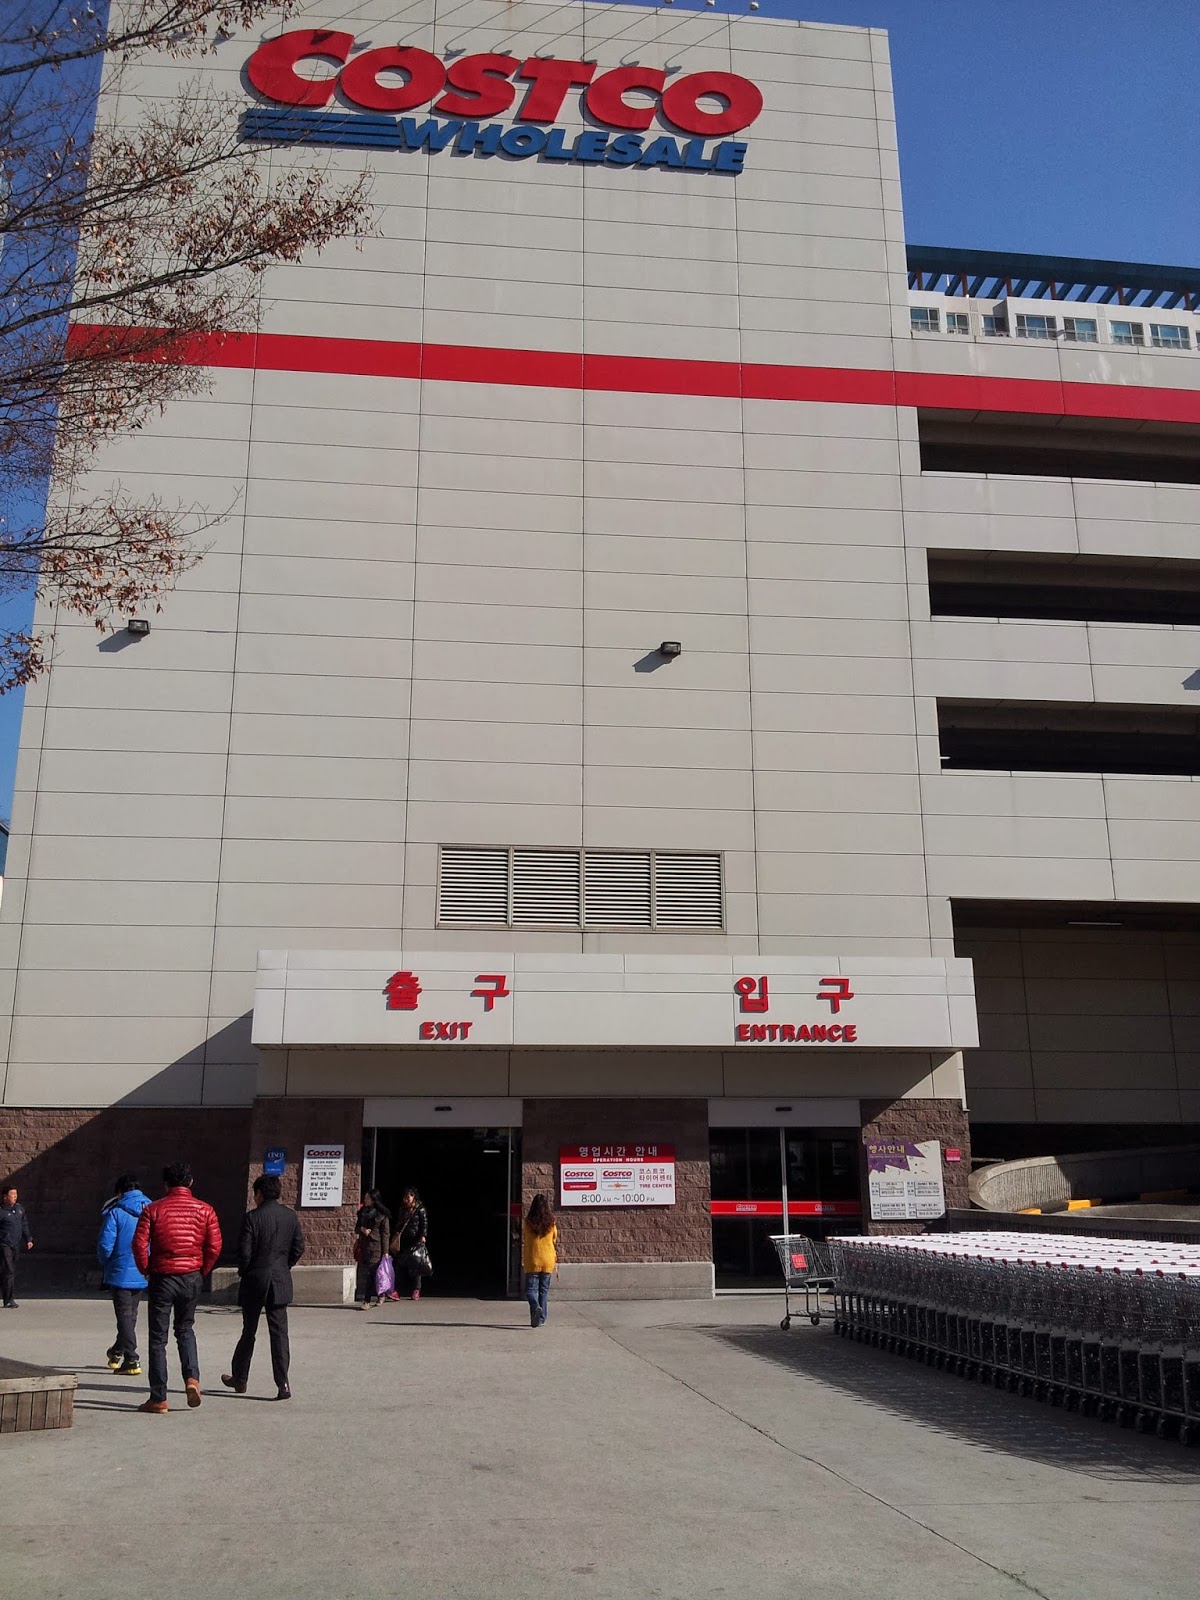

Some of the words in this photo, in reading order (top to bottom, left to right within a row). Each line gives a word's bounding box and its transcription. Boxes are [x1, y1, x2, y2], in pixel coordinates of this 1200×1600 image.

[243, 29, 764, 136] COSTCO
[398, 117, 748, 173] WHOLESALE
[419, 1021, 473, 1040] EXIT
[735, 1023, 858, 1043] ENTRANCE
[307, 1149, 341, 1157] COSTCO
[579, 1146, 626, 1157] 영업시간
[635, 1146, 658, 1156] 안내
[581, 1194, 601, 1203] 8:00
[621, 1193, 645, 1203] 10:00
